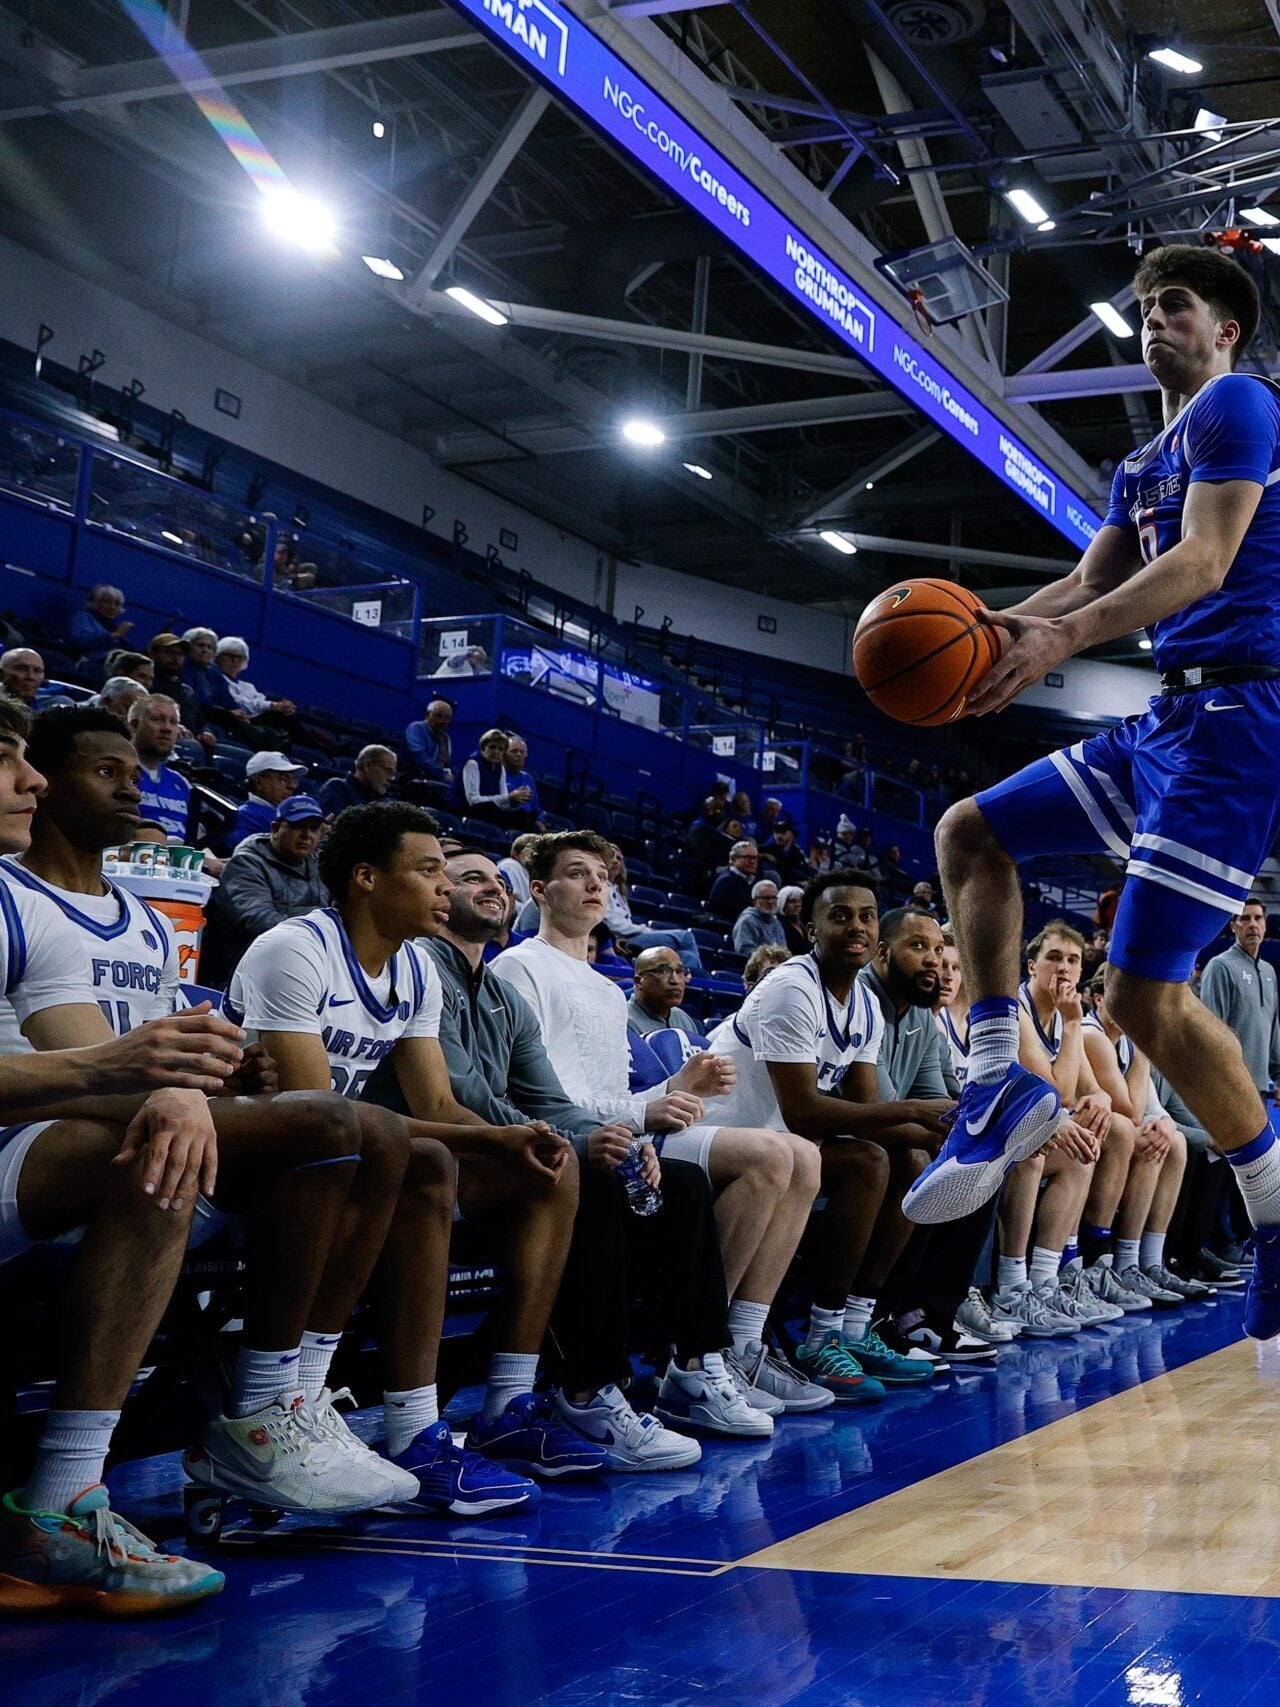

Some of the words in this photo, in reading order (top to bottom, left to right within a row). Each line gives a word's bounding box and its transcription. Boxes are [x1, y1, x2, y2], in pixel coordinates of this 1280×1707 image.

[603, 75, 751, 227] NGC.com/Careers
[785, 234, 857, 311] NORTHROP
[794, 269, 864, 345] GRUMMAN
[894, 344, 980, 437] NGC.com/Careers
[322, 1026, 355, 1056] AIR
